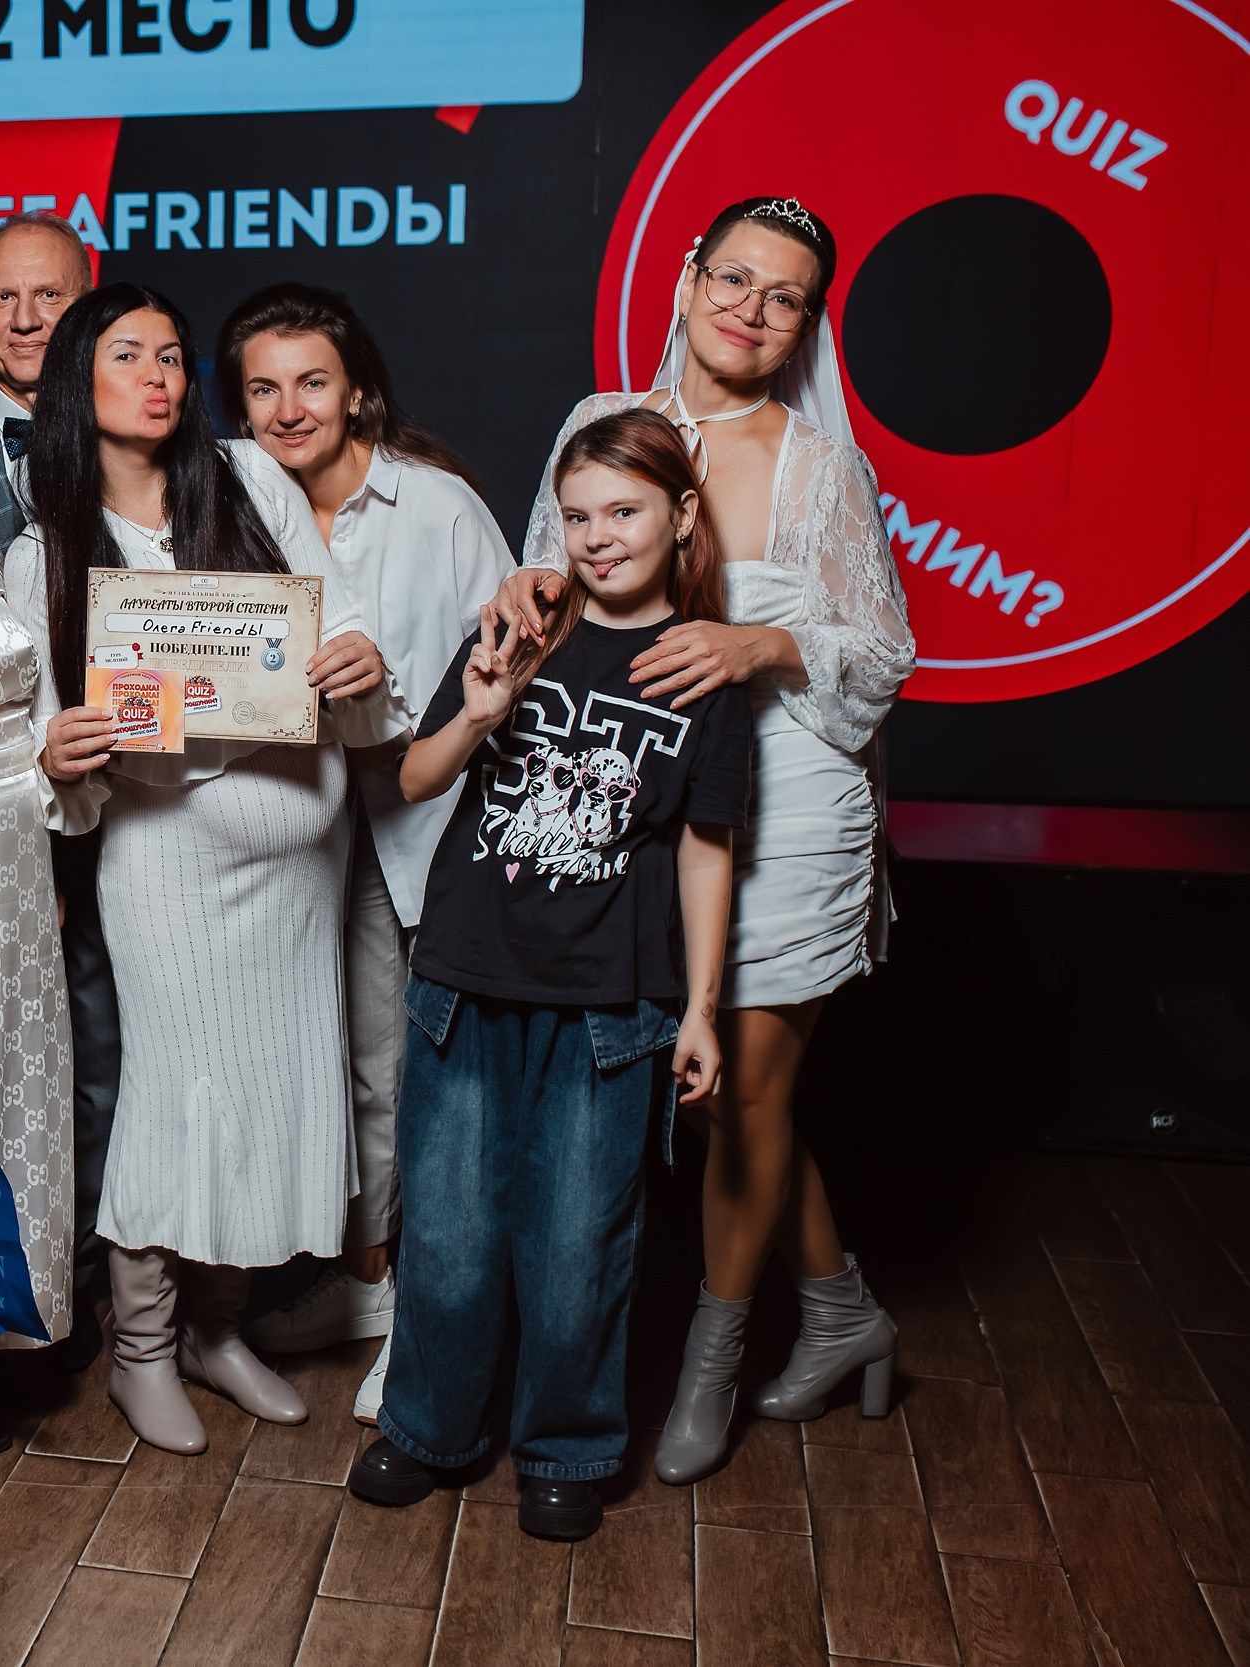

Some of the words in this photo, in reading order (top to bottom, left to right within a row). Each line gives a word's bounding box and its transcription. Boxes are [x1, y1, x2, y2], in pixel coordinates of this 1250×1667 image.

[1004, 79, 1168, 191] QUIZ
[119, 598, 184, 611] ЛАУРЕАТЫ
[185, 599, 235, 613] ВТОРОЙ
[236, 602, 289, 615] СТЕПЕНИ
[149, 642, 250, 657] ПОБЕДИТЕЛИ!
[187, 686, 210, 696] QUIZ
[122, 708, 149, 719] QUIZ
